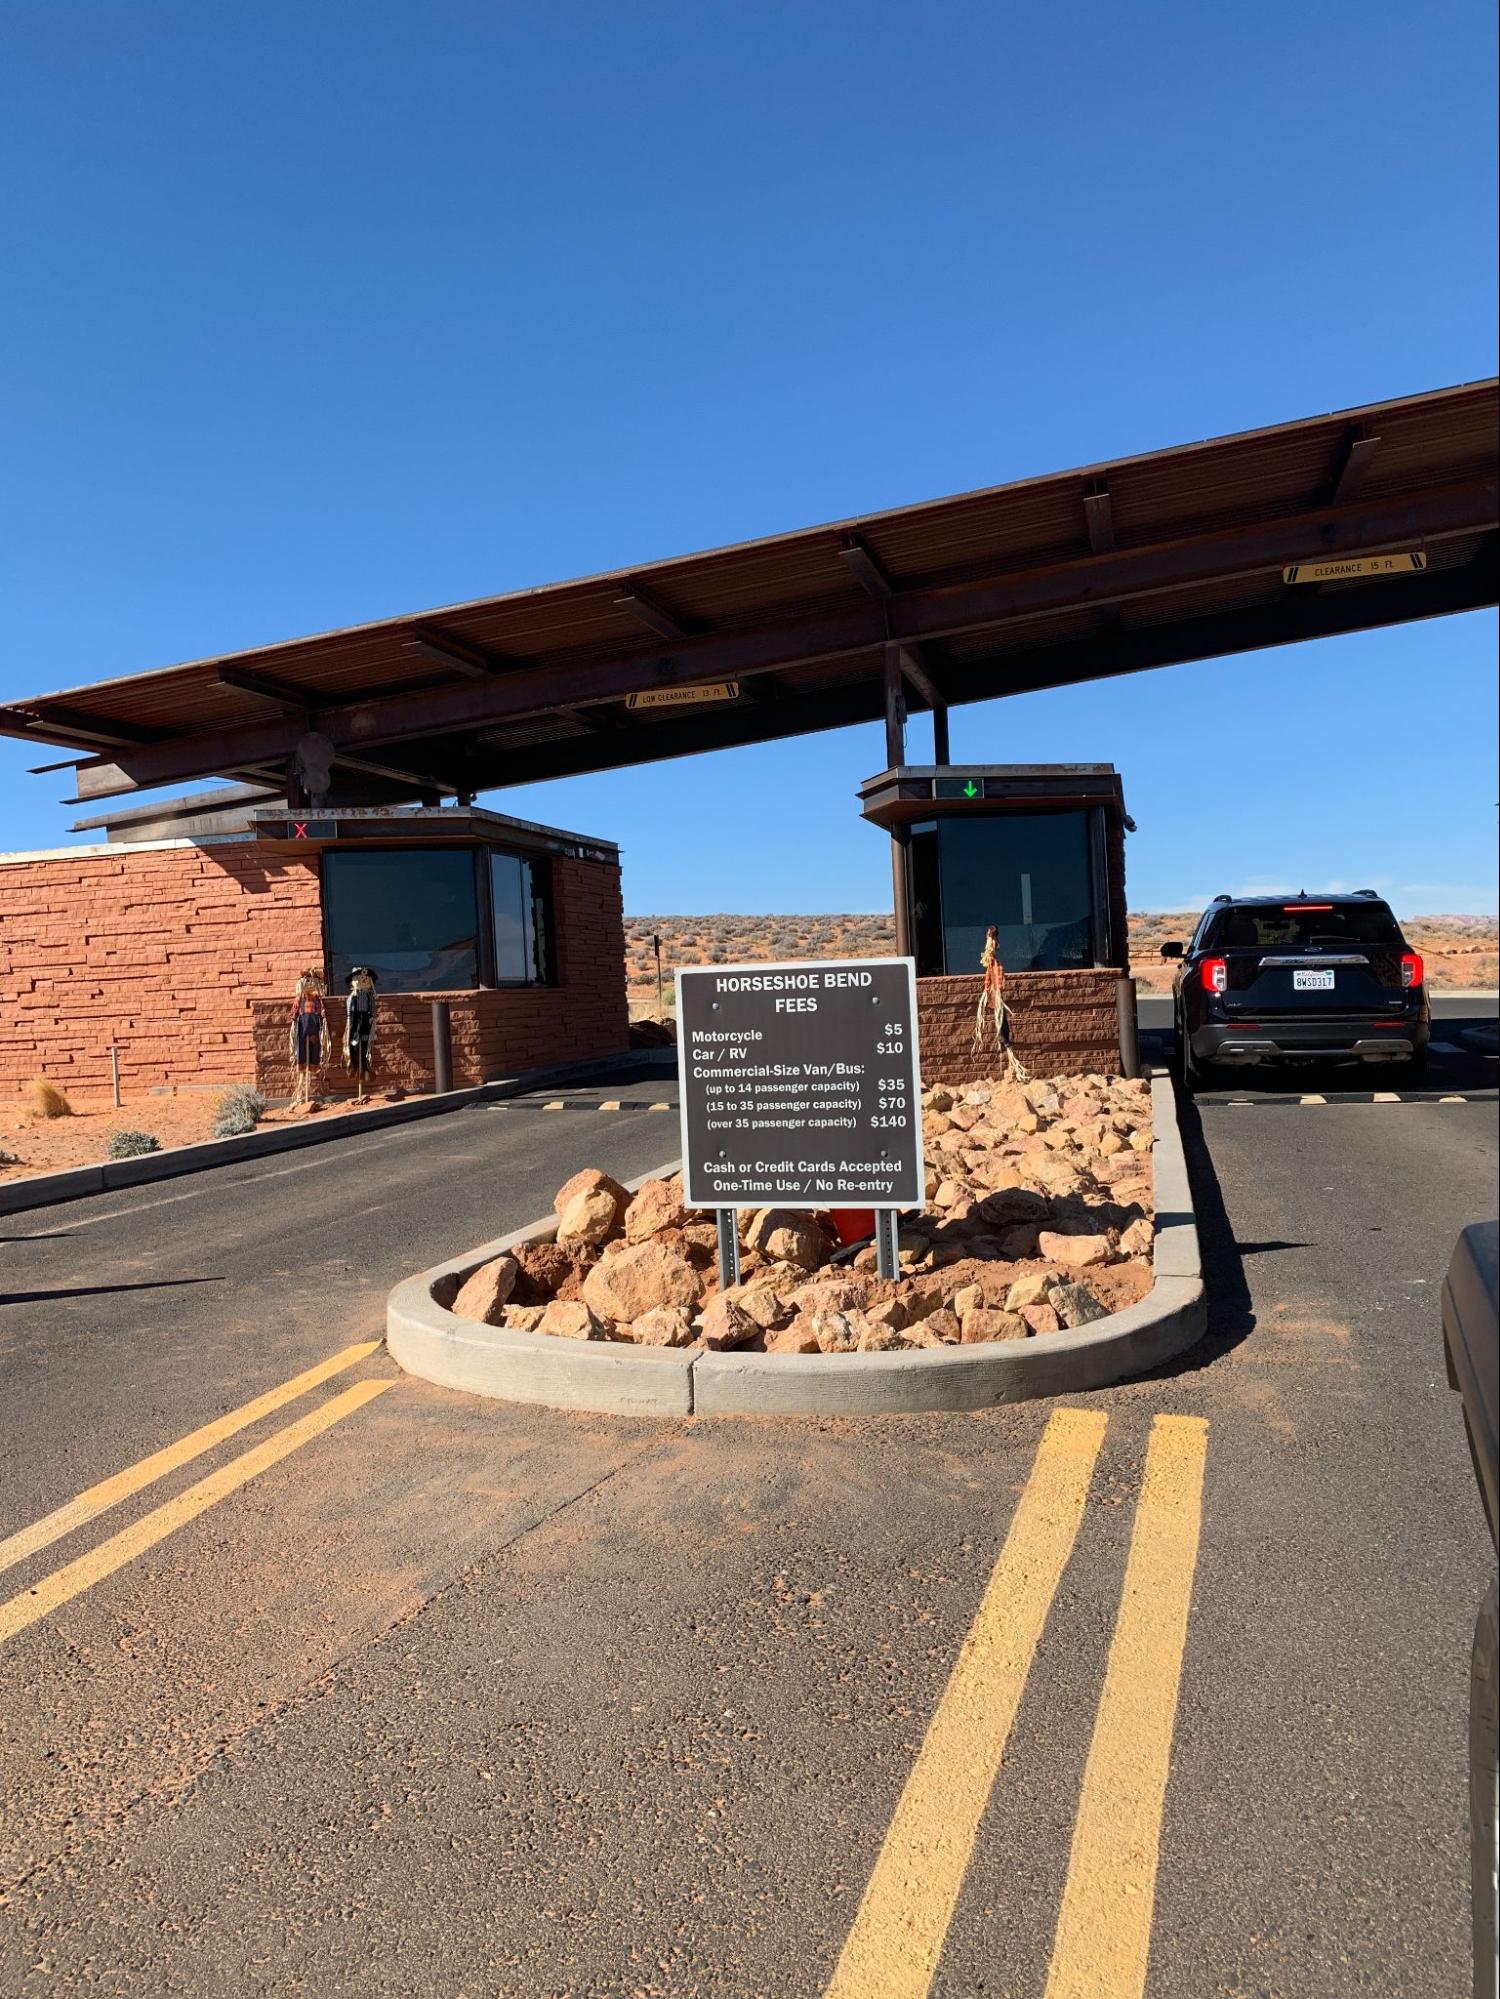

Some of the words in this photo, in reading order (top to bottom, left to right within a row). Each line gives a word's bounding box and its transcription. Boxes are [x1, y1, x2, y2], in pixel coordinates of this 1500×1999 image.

[1315, 564, 1362, 576] CLEARANCE
[1371, 561, 1379, 570] 15
[642, 695, 656, 703] LOW
[658, 691, 696, 702] CLEARANCE
[717, 974, 819, 992] HORSESHOE
[825, 972, 872, 987] BEND
[1297, 977, 1332, 987] 8WSD317
[776, 998, 817, 1012] FEES
[692, 1030, 762, 1043] Motorcycle
[885, 1023, 902, 1036] $5
[693, 1049, 714, 1060] Car
[717, 1048, 725, 1062] /
[730, 1048, 747, 1059] RV
[877, 1042, 903, 1054] $10
[694, 1065, 800, 1078] Commercial-Size
[803, 1063, 864, 1077] Van/Bus:
[706, 1085, 722, 1095] (up
[725, 1084, 735, 1093] to
[739, 1083, 752, 1092] 14
[755, 1084, 808, 1094] passenger
[811, 1081, 859, 1092] capacity)
[878, 1079, 904, 1091] $35
[707, 1102, 724, 1112] (15
[727, 1102, 737, 1110] to
[740, 1101, 753, 1110] 35
[757, 1101, 810, 1111] passenger
[813, 1099, 861, 1110] capacity)
[879, 1097, 905, 1109] $70
[708, 1120, 732, 1130] (over
[736, 1119, 749, 1128] 35
[752, 1119, 805, 1129] passenger
[808, 1117, 856, 1128] capacity)
[871, 1116, 906, 1128] $140
[704, 1162, 735, 1173] Cash
[739, 1164, 752, 1172] or
[755, 1161, 794, 1172] Credit
[798, 1161, 835, 1172] Cards
[839, 1160, 901, 1174] Accepted
[714, 1179, 772, 1191] One-Time
[777, 1180, 800, 1190] Use
[804, 1179, 811, 1193] /
[816, 1179, 833, 1190] No
[838, 1179, 893, 1193] Re-entry
